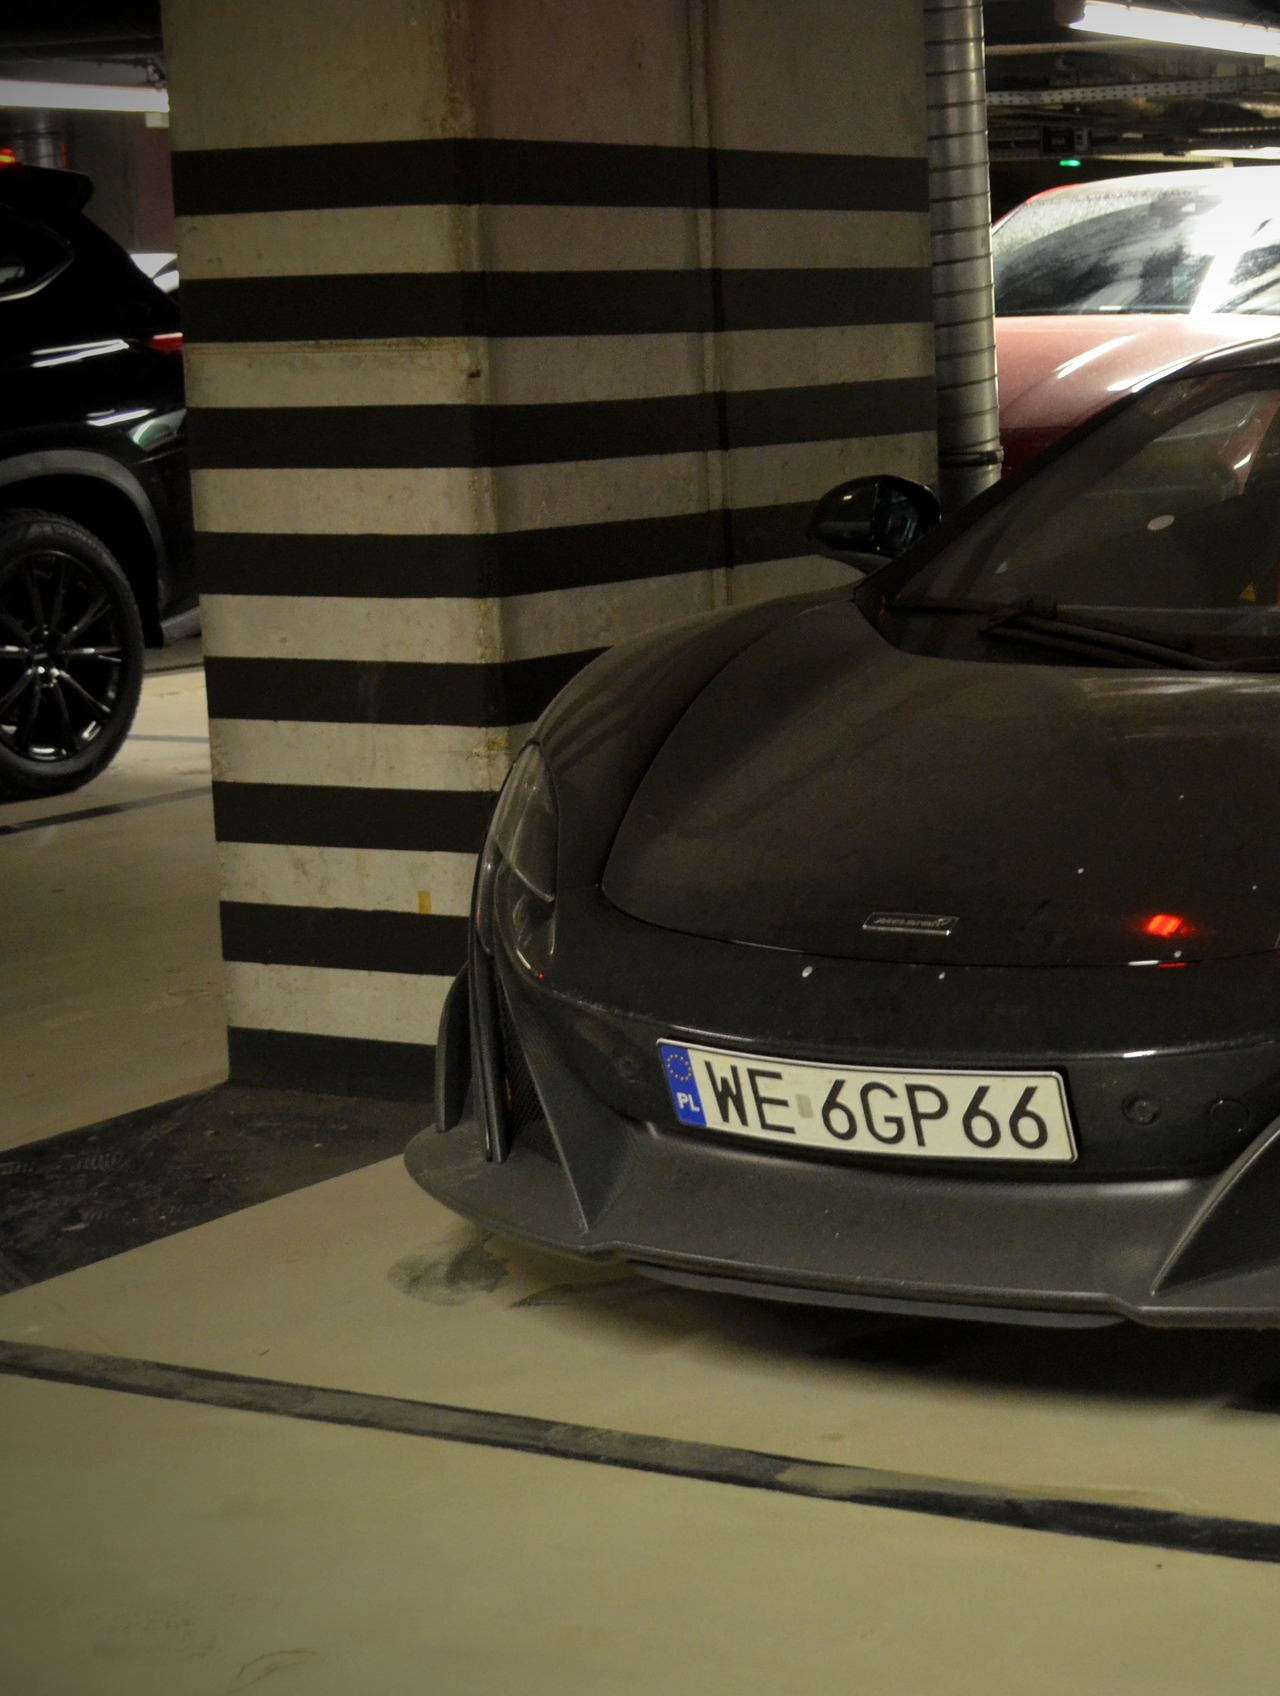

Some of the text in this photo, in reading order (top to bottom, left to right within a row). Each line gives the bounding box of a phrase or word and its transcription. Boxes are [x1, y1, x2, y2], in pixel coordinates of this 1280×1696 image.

[677, 1091, 700, 1112] PL
[704, 1060, 1049, 1149] WE 6GP66
